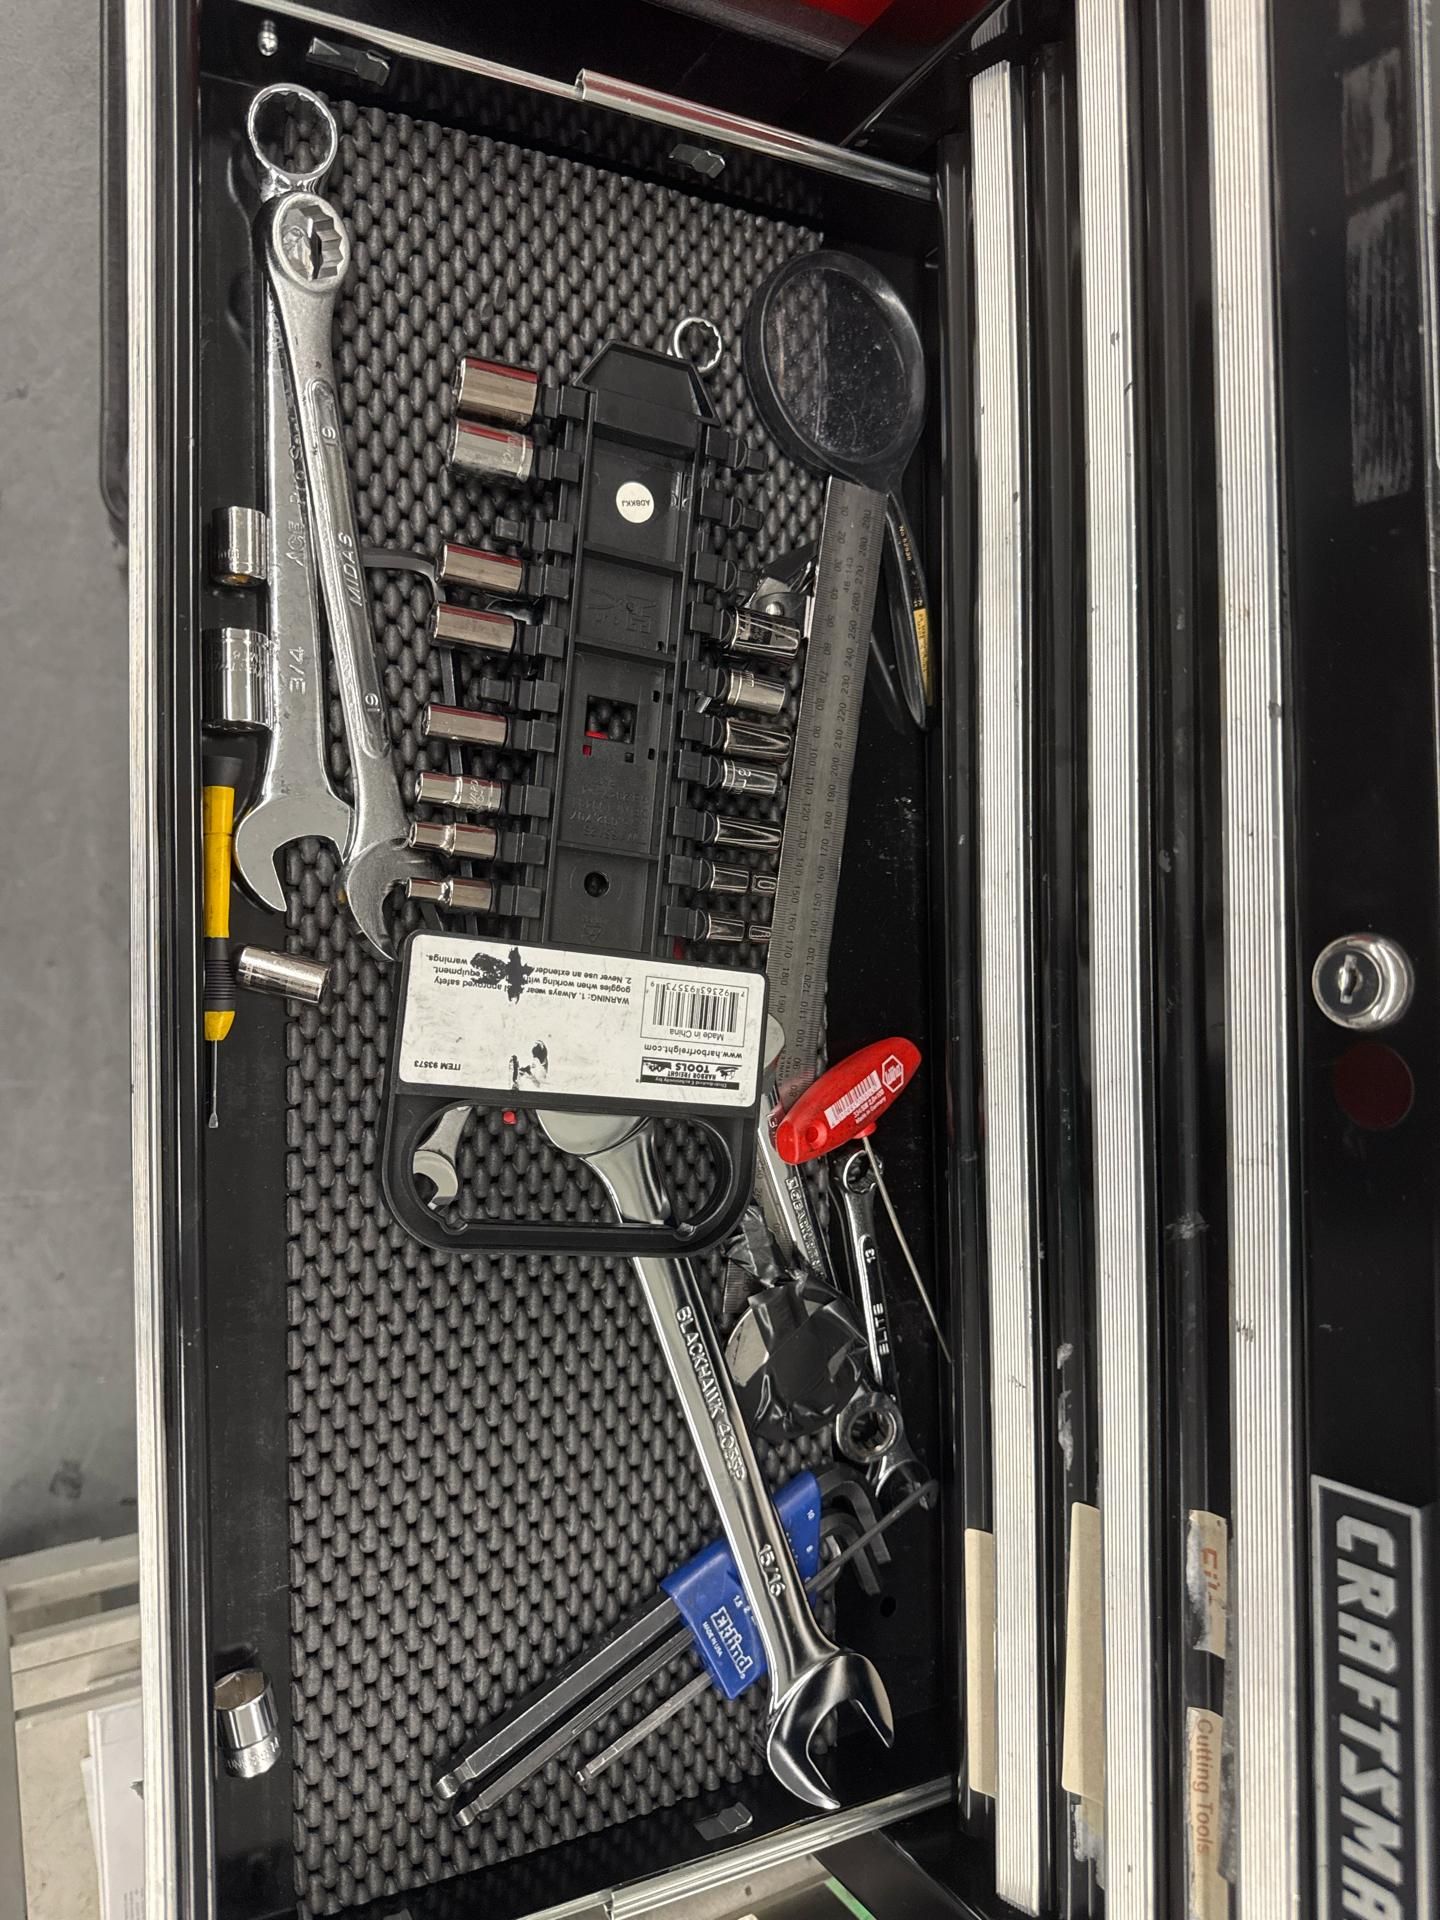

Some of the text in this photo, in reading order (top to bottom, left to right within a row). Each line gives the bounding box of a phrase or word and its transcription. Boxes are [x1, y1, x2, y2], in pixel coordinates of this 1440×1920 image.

[338, 531, 363, 607] MIDAS
[289, 646, 306, 695] 3/4
[840, 674, 850, 695] 230
[836, 701, 847, 722] 220
[833, 728, 844, 750] 210
[830, 756, 840, 777] 200
[827, 784, 836, 803] 190
[823, 811, 833, 830] 180
[820, 838, 829, 857] 170
[816, 865, 826, 885] 160
[813, 892, 822, 912] 150
[788, 912, 797, 931] 160
[809, 919, 819, 939] 140
[784, 939, 794, 959] 170
[806, 946, 815, 966] 130
[425, 954, 468, 966] warnings.
[534, 966, 571, 977] extender
[584, 972, 599, 980] use
[600, 974, 623, 984] Never
[625, 976, 632, 985] 2.
[780, 966, 790, 986] 180
[433, 976, 461, 988] safety
[526, 986, 546, 995] wear
[542, 977, 575, 989] working
[576, 981, 598, 990] when
[600, 982, 631, 994] goggles
[665, 981, 696, 993] 93573
[700, 985, 730, 997] 92363
[802, 974, 812, 993] 120
[548, 988, 577, 1000] Always
[578, 993, 586, 1001] 1.
[587, 995, 630, 1005] WARNING:
[777, 994, 787, 1014] 190
[799, 1001, 809, 1020] 110
[669, 1028, 724, 1041] Made in China
[796, 1028, 805, 1048] 100
[643, 1044, 743, 1059] www.harborfreight.com
[414, 1060, 461, 1071] ITEM 93573
[675, 1062, 710, 1074] TOOLS
[667, 1071, 717, 1080] HARBOR FREIGHT
[865, 1248, 876, 1263] 13
[873, 1302, 890, 1356] ELITE
[758, 1543, 787, 1598] 15/16
[710, 1606, 754, 1676] Eklind
[1193, 1717, 1214, 1857] Cutting Tools
